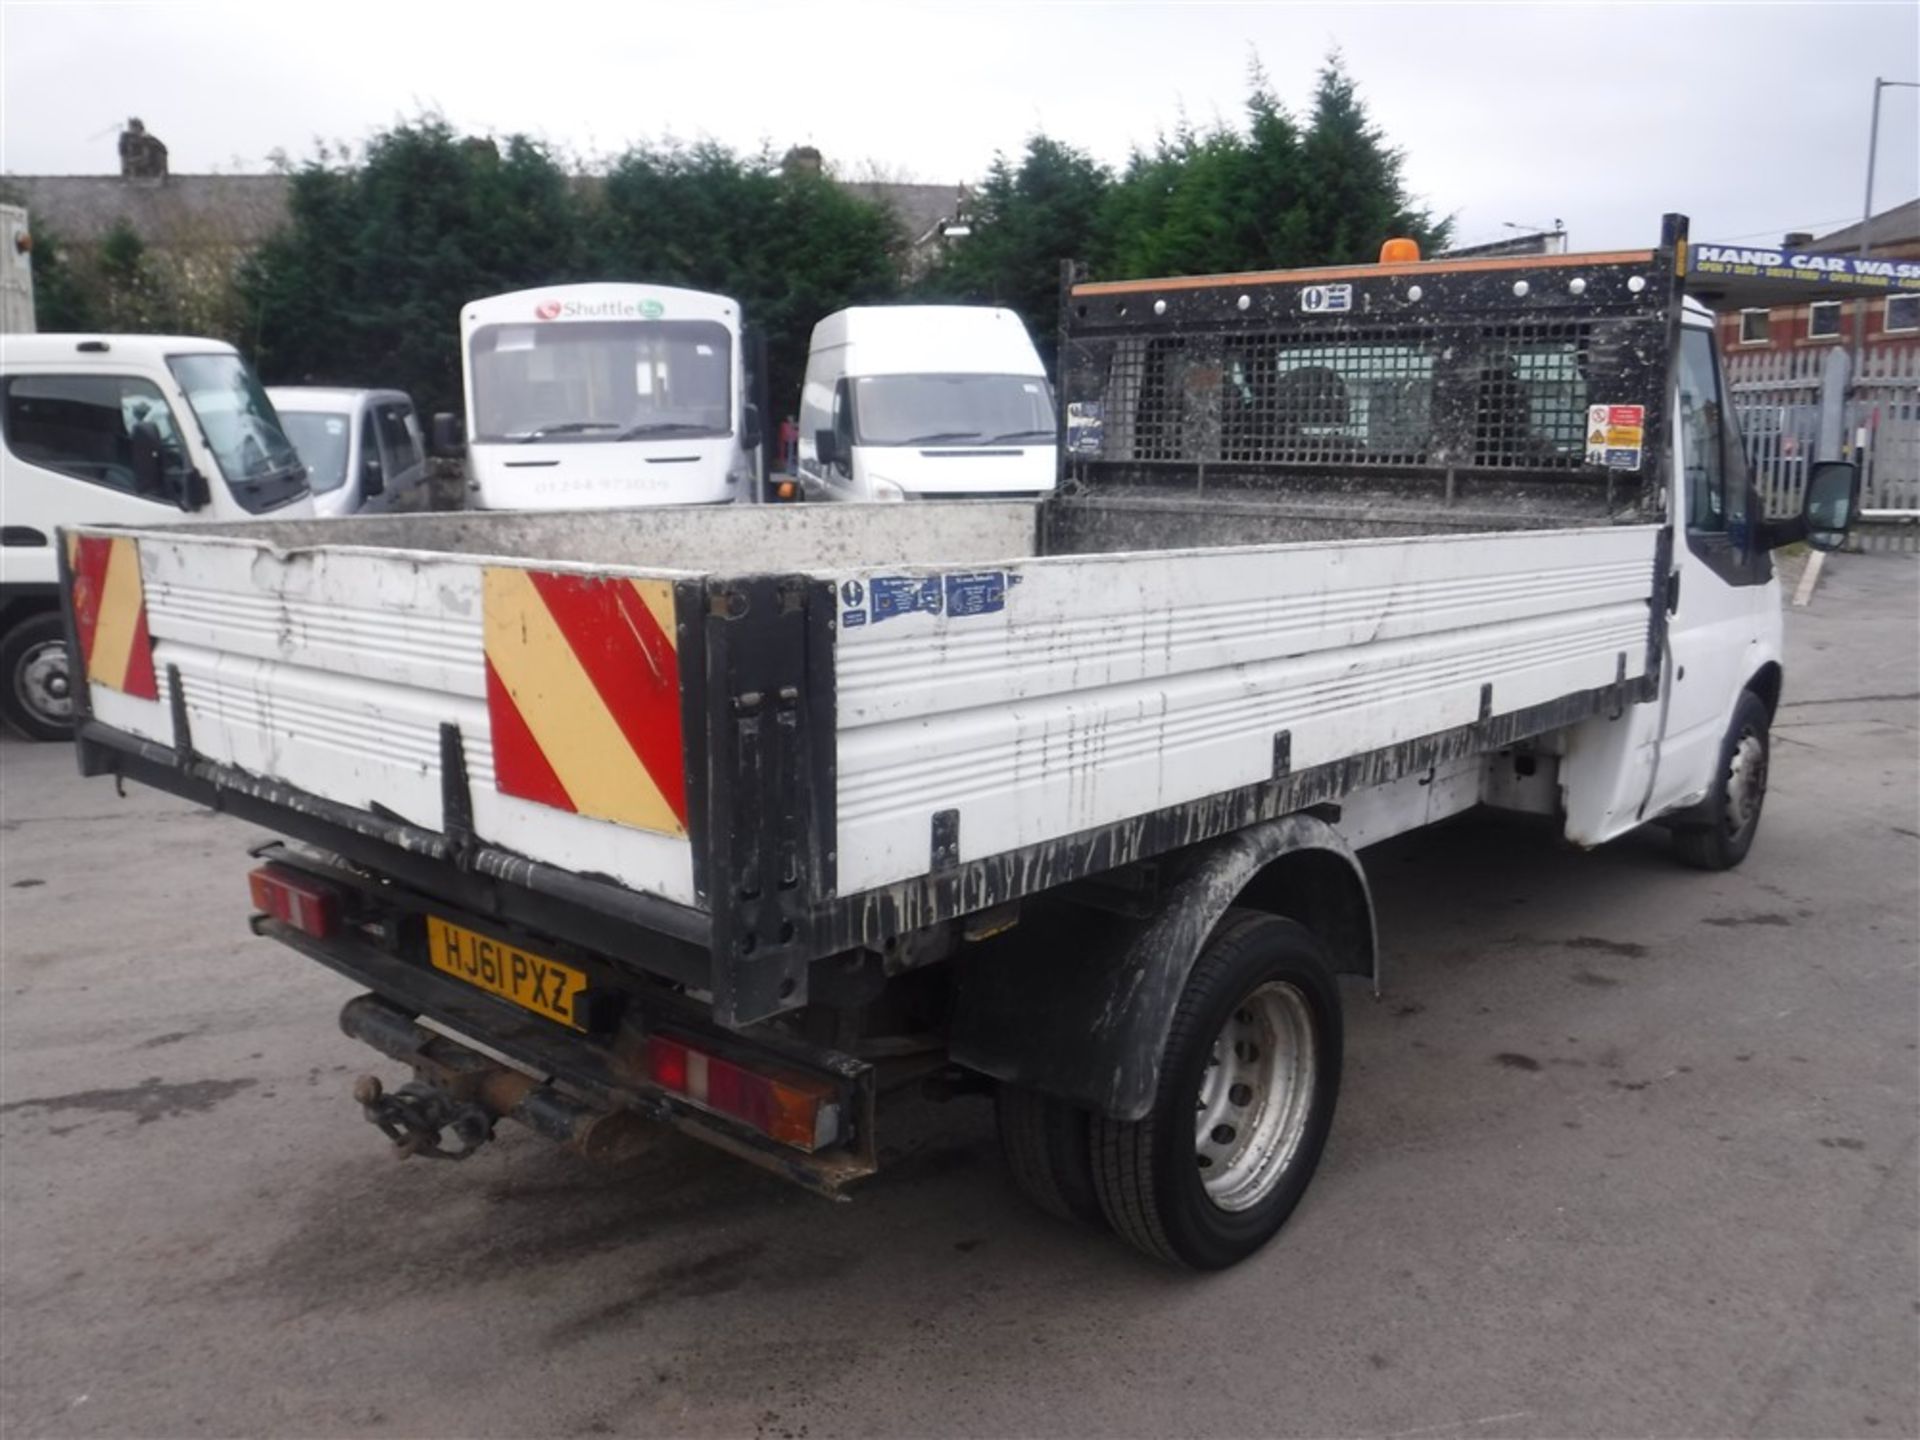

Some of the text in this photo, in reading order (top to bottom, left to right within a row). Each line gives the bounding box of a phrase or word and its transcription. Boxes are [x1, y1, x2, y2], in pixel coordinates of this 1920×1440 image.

[1697, 247, 1784, 266] HAND
[1790, 254, 1845, 272] CAR
[563, 300, 634, 317] Shuttle
[443, 925, 569, 1017] HJ61 PXZ
